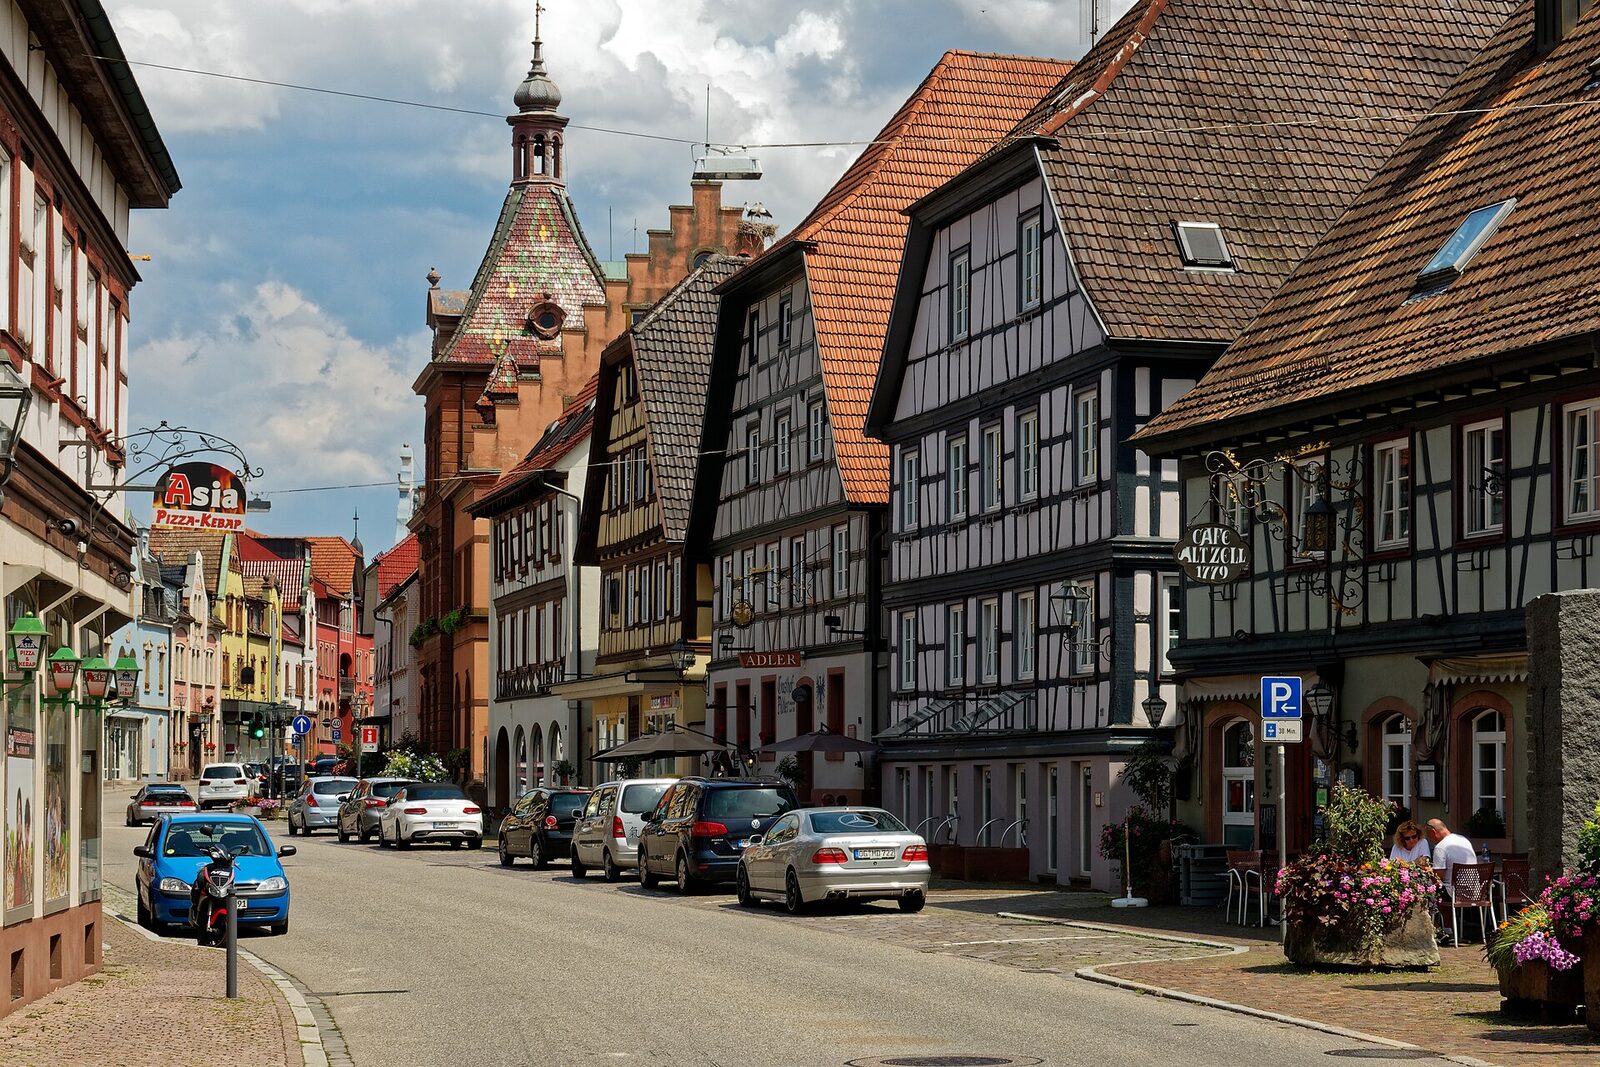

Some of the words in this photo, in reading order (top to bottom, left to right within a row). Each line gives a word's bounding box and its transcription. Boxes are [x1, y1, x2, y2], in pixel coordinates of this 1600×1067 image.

[164, 472, 239, 510] Asia
[1192, 527, 1231, 547] CAFE
[1196, 565, 1229, 580] 1779
[745, 653, 797, 666] ADLER
[53, 662, 75, 673] Asia
[1271, 682, 1292, 713] P
[237, 900, 246, 908] 91
